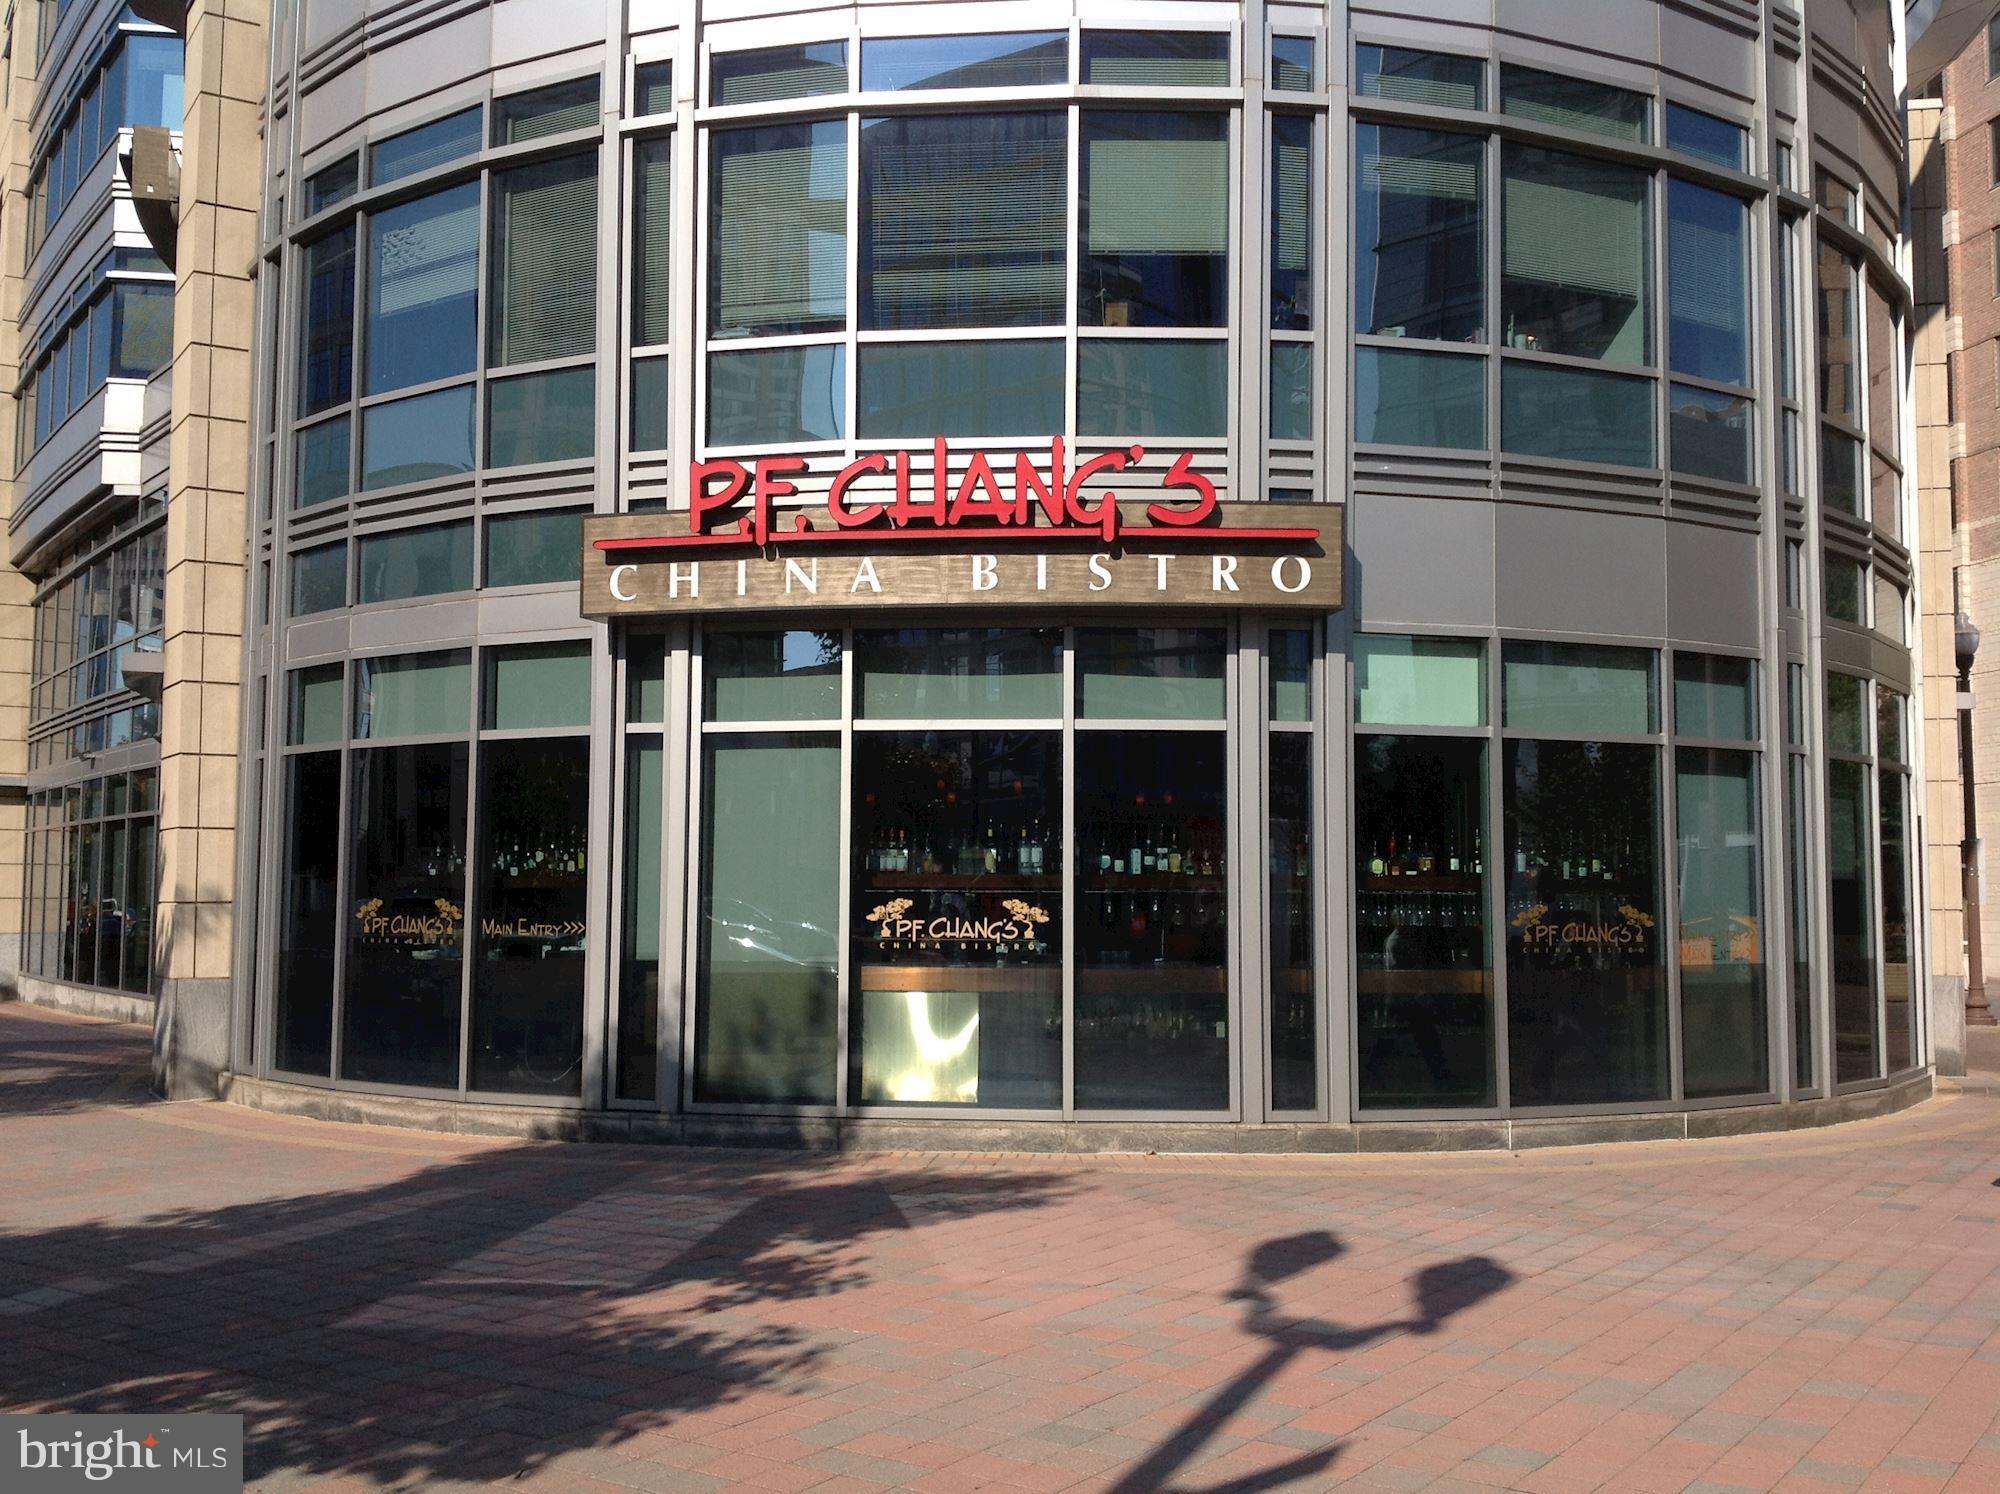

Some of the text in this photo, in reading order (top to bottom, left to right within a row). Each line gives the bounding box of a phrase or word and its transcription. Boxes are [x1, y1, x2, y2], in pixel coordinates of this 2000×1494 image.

[829, 436, 1218, 542] CHANG'S
[608, 552, 1314, 602] CHINA BISTRO
[928, 917, 1019, 944] CHANG'S
[1561, 922, 1632, 947] CHANG'S
[879, 942, 1036, 950] CHINA BISTRO
